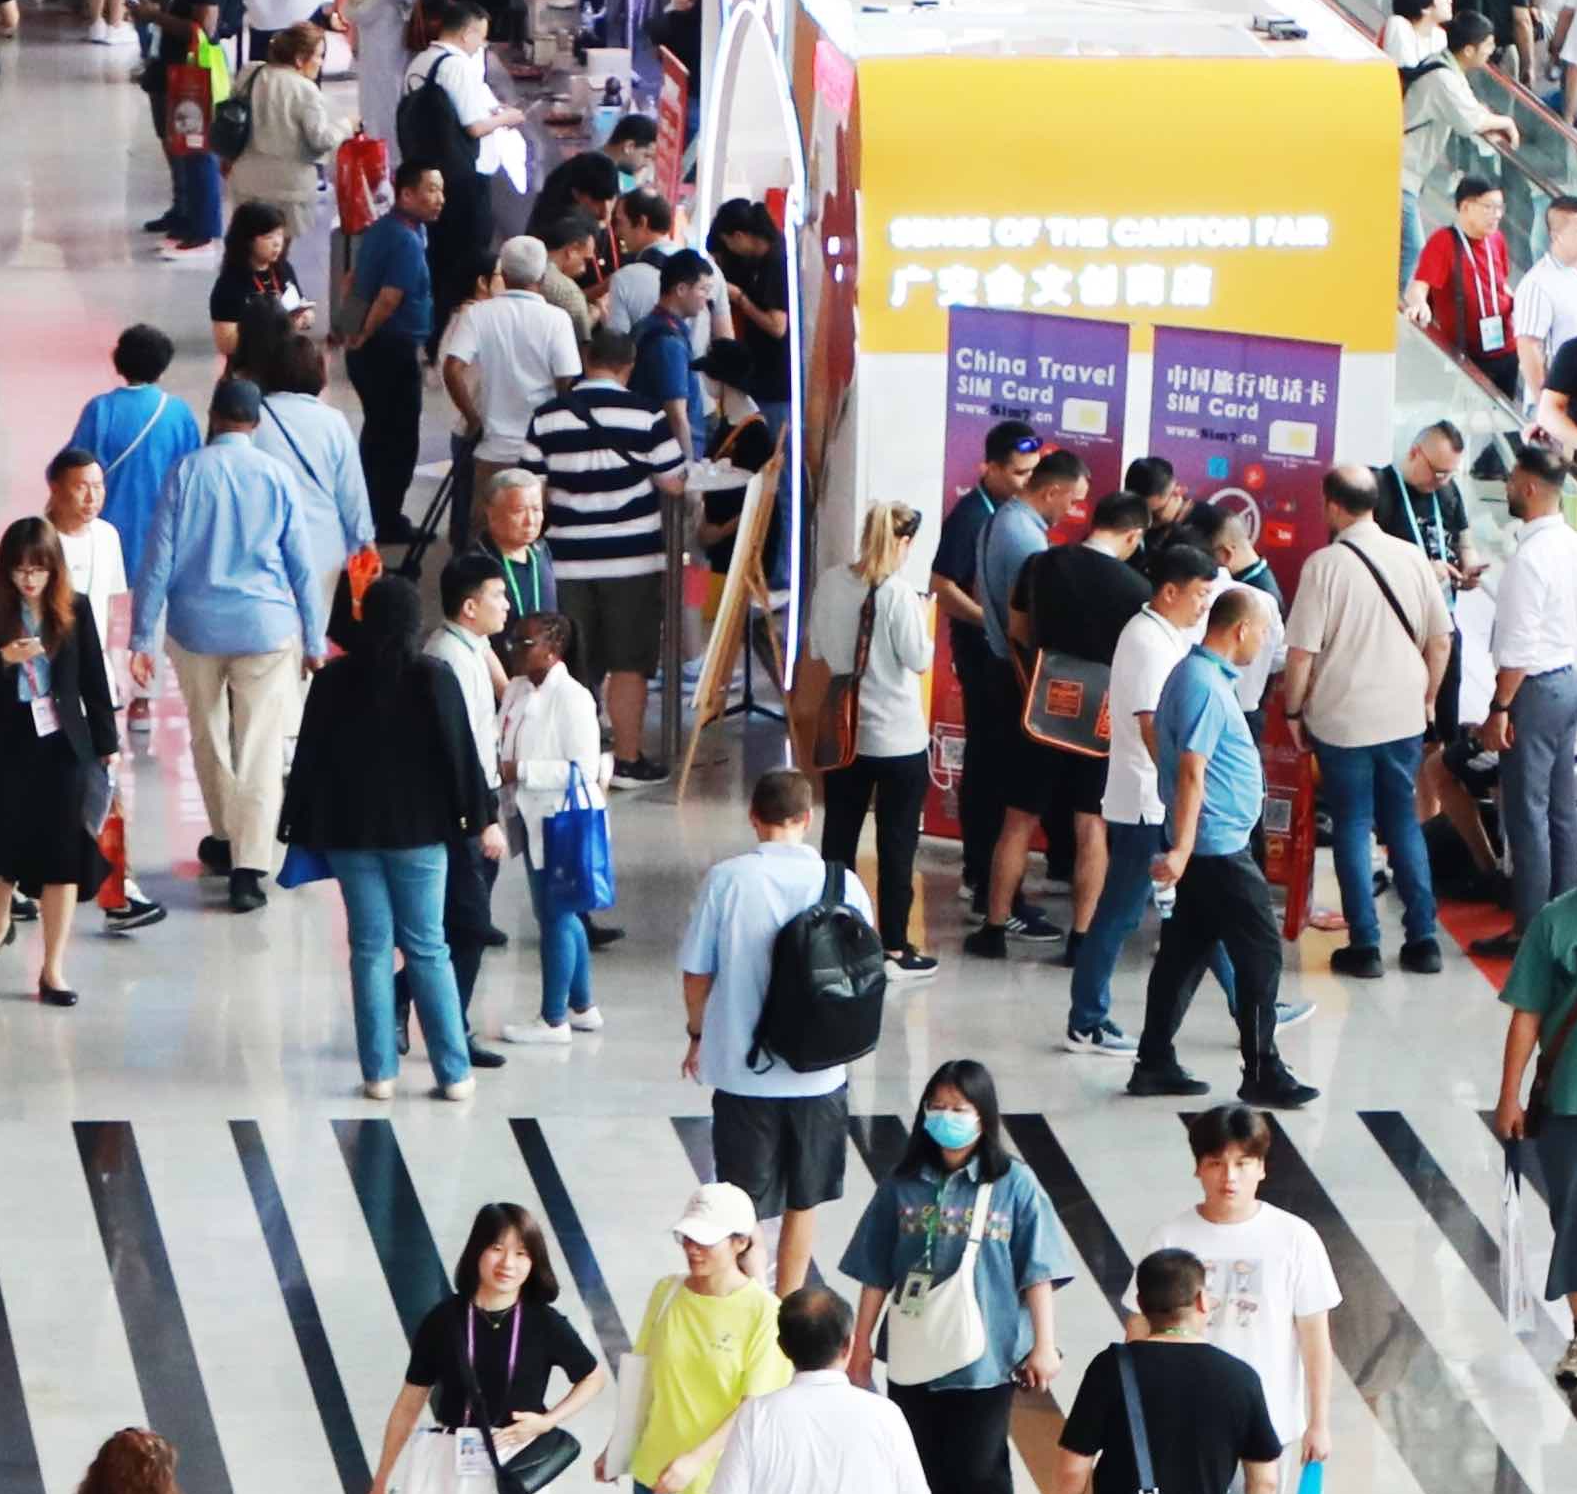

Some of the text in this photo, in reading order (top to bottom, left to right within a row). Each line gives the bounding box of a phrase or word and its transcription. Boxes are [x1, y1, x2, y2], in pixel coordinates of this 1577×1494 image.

[994, 218, 1042, 248] OF
[1112, 216, 1251, 247] CANTON
[956, 348, 1116, 388] China Travel
[956, 374, 1054, 404] SIM Card
[1167, 364, 1327, 406] 中国旅行电话卡
[1166, 392, 1259, 422] SIM Card
